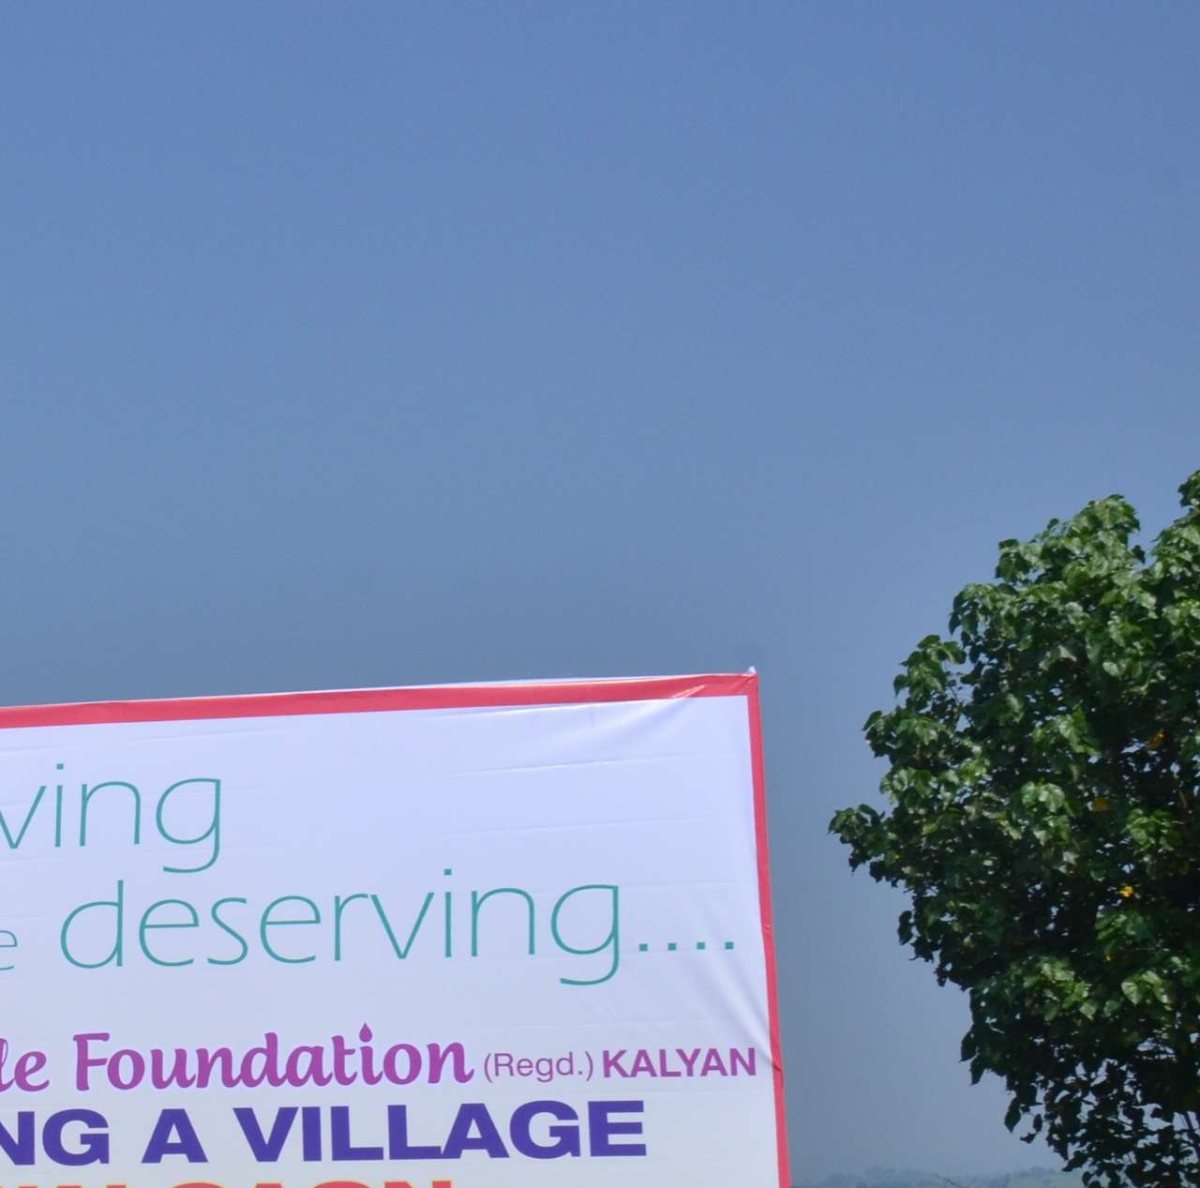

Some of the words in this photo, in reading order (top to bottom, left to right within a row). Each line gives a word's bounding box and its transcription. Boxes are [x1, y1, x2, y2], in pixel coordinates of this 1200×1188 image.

[73, 1022, 475, 1092] Foundation
[484, 1051, 594, 1083] (Regd.)
[602, 1047, 757, 1078] KALYAN
[141, 1108, 208, 1164] A
[233, 1100, 648, 1163] VILLAGE
